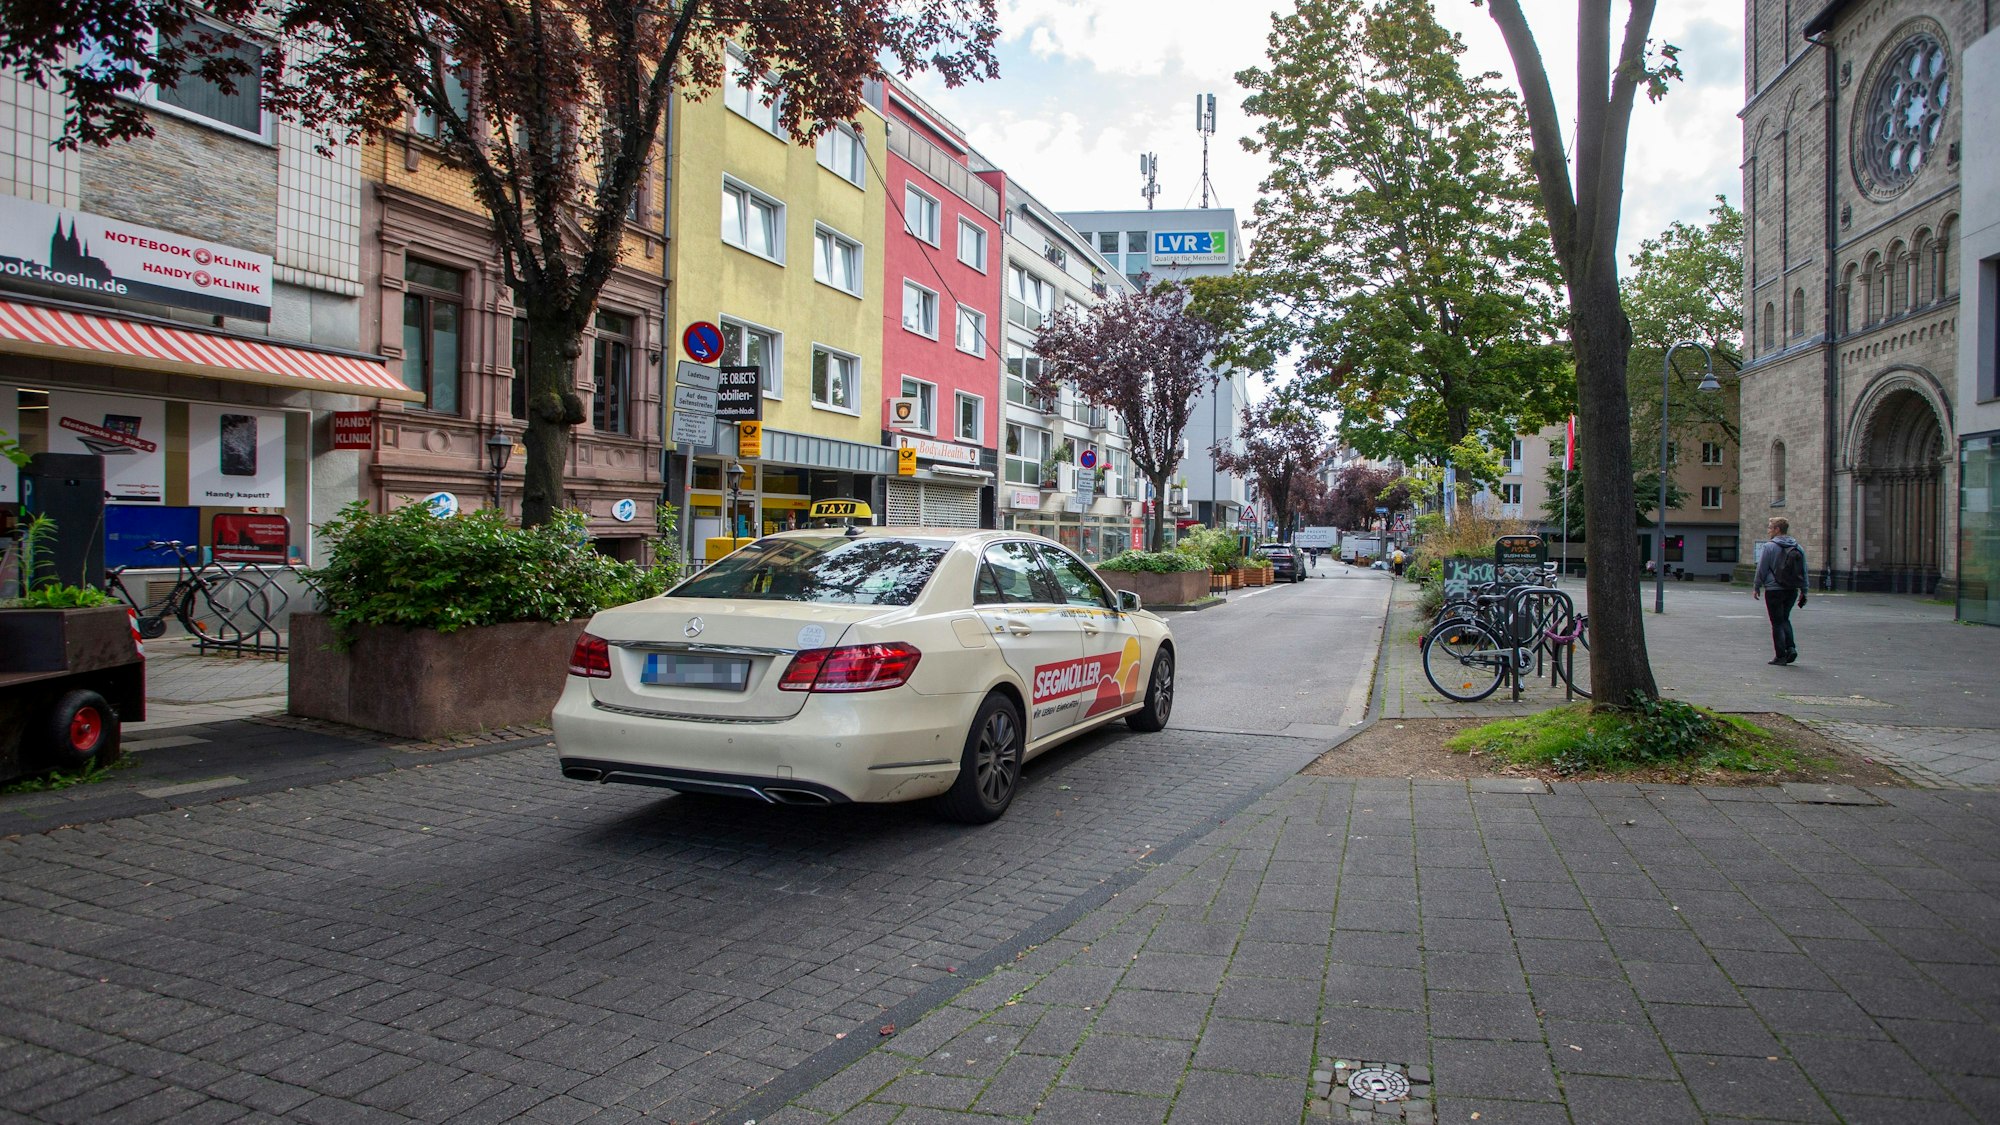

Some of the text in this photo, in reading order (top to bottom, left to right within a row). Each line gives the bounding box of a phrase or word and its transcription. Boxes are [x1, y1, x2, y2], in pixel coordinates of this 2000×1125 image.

[1158, 235, 1198, 251] LVR
[105, 230, 261, 273] NOTEBOOK KLINIK
[1193, 254, 1226, 262] Menschen
[143, 262, 260, 294] HANDY KLINIK
[687, 371, 710, 381] Ladezone
[730, 371, 756, 385] OBJECTS
[678, 398, 713, 409] Seitenstreifen
[335, 417, 371, 428] HANDY
[63, 420, 110, 438] Notebooks
[111, 434, 123, 442] ab
[335, 433, 371, 443] KLINIK
[920, 441, 937, 458] Body
[941, 444, 964, 459] Health
[205, 491, 270, 499] Handy kaputt?
[821, 504, 852, 514] TAXI
[1034, 661, 1101, 699] SEGMÜLLER
